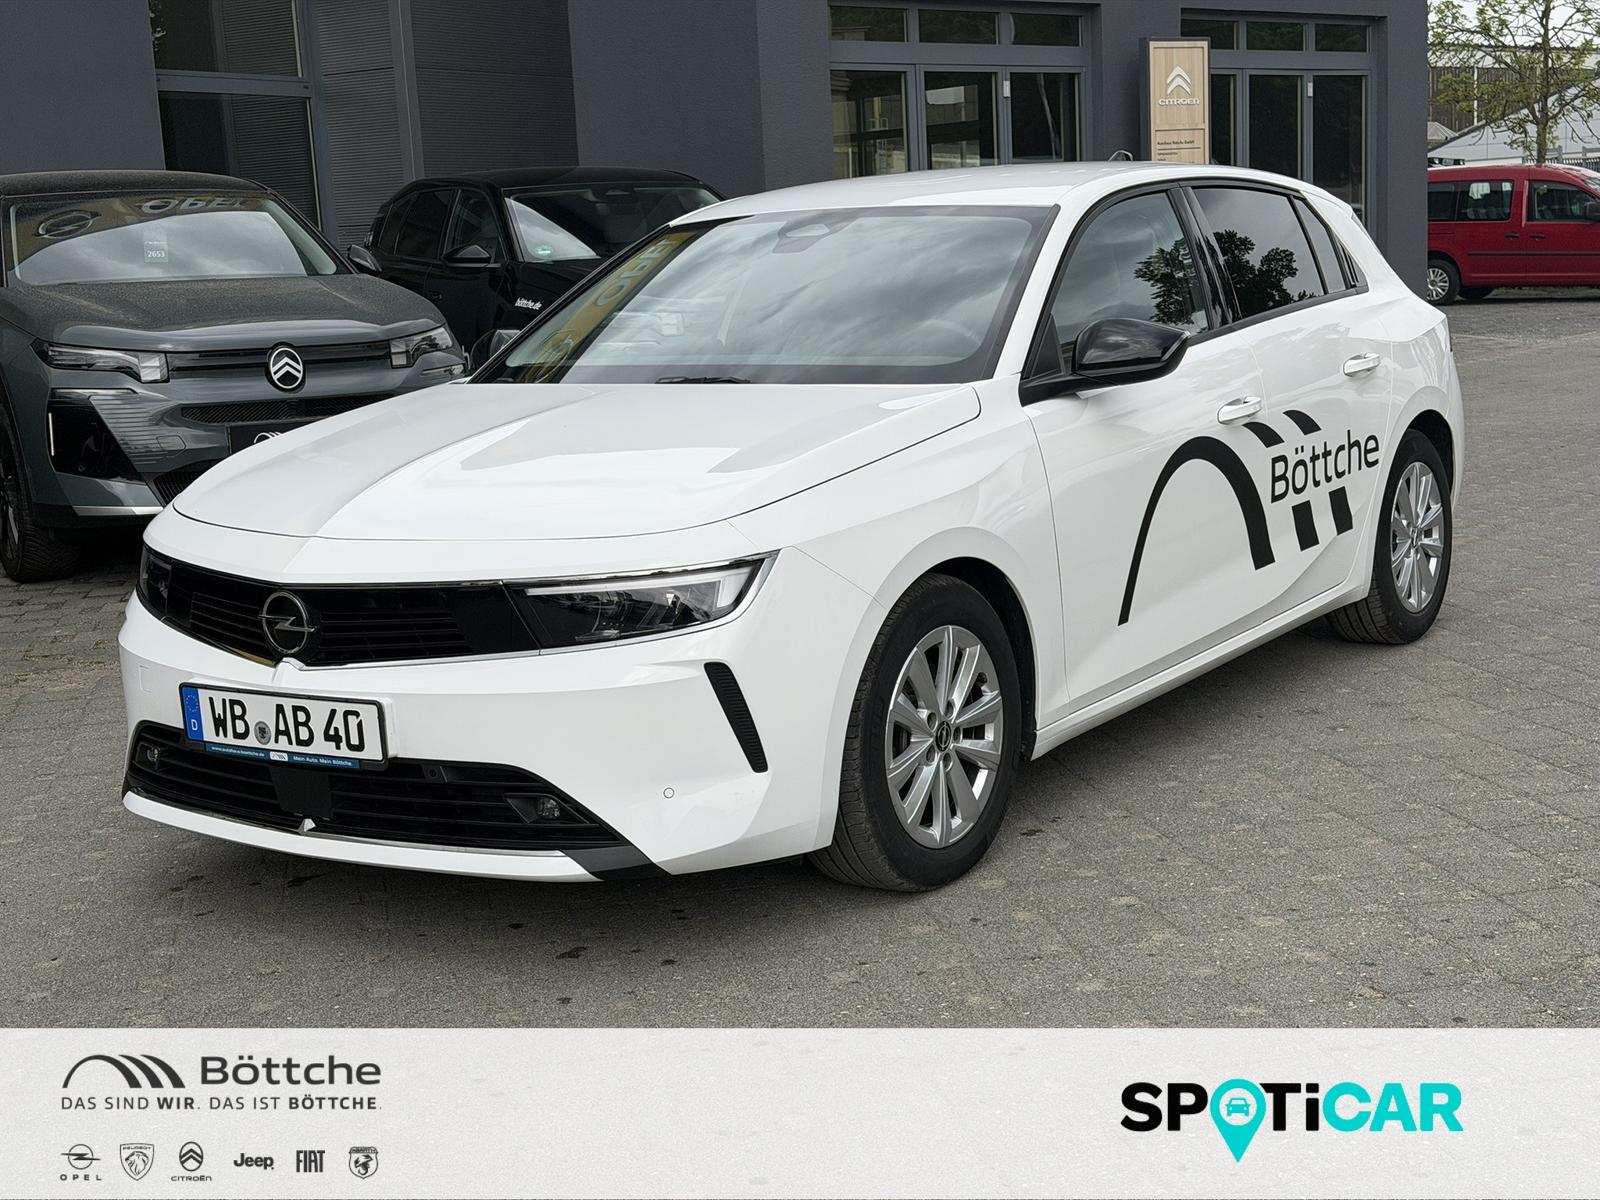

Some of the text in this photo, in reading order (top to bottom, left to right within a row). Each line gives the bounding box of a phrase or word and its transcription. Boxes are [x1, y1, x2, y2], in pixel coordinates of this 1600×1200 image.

[1271, 429, 1379, 504] Böttche
[191, 718, 199, 731] D
[209, 696, 365, 752] WB AB 40
